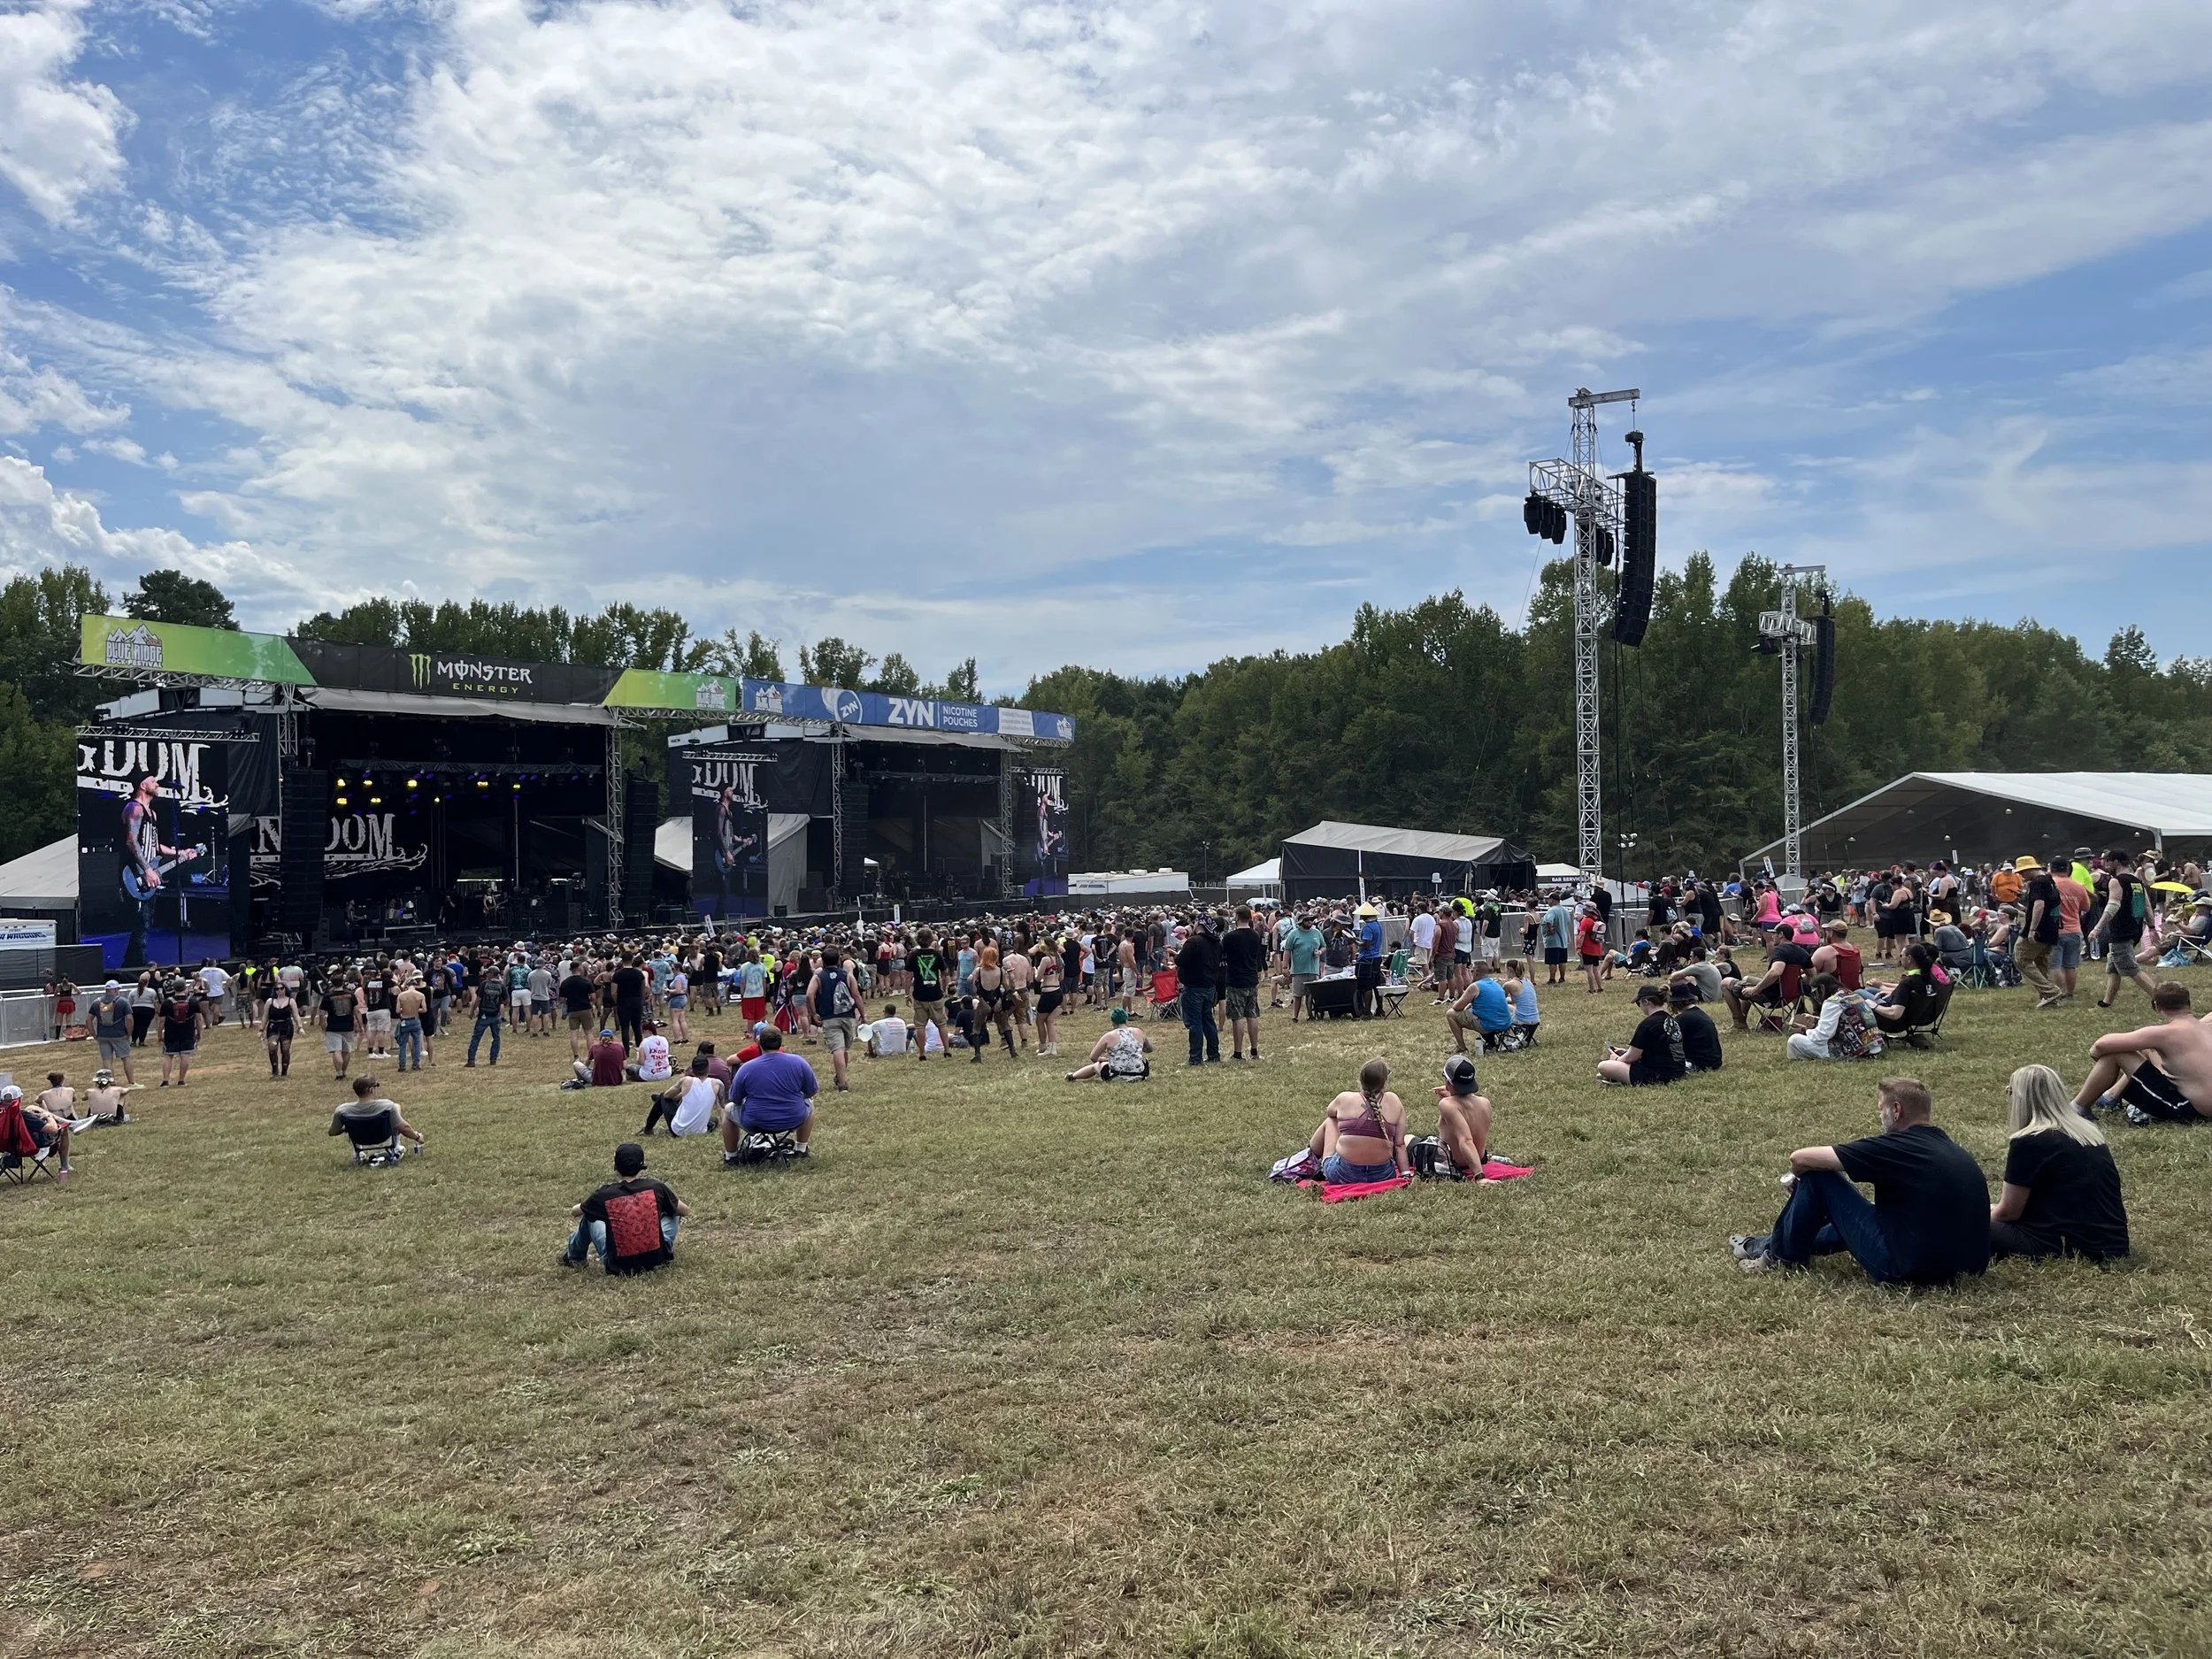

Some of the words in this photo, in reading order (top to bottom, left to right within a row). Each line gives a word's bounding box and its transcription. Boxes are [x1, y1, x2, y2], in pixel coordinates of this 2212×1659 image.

[106, 641, 131, 660] BLUE
[134, 643, 162, 663] RIDGE
[127, 659, 163, 668] FESTIVAL
[437, 659, 533, 684] MONSTER
[453, 682, 518, 694] ENERGY
[841, 700, 859, 718] ZYN
[887, 697, 934, 727] ZYN
[942, 705, 978, 718] NICOTINE
[943, 716, 979, 728] POUCHES
